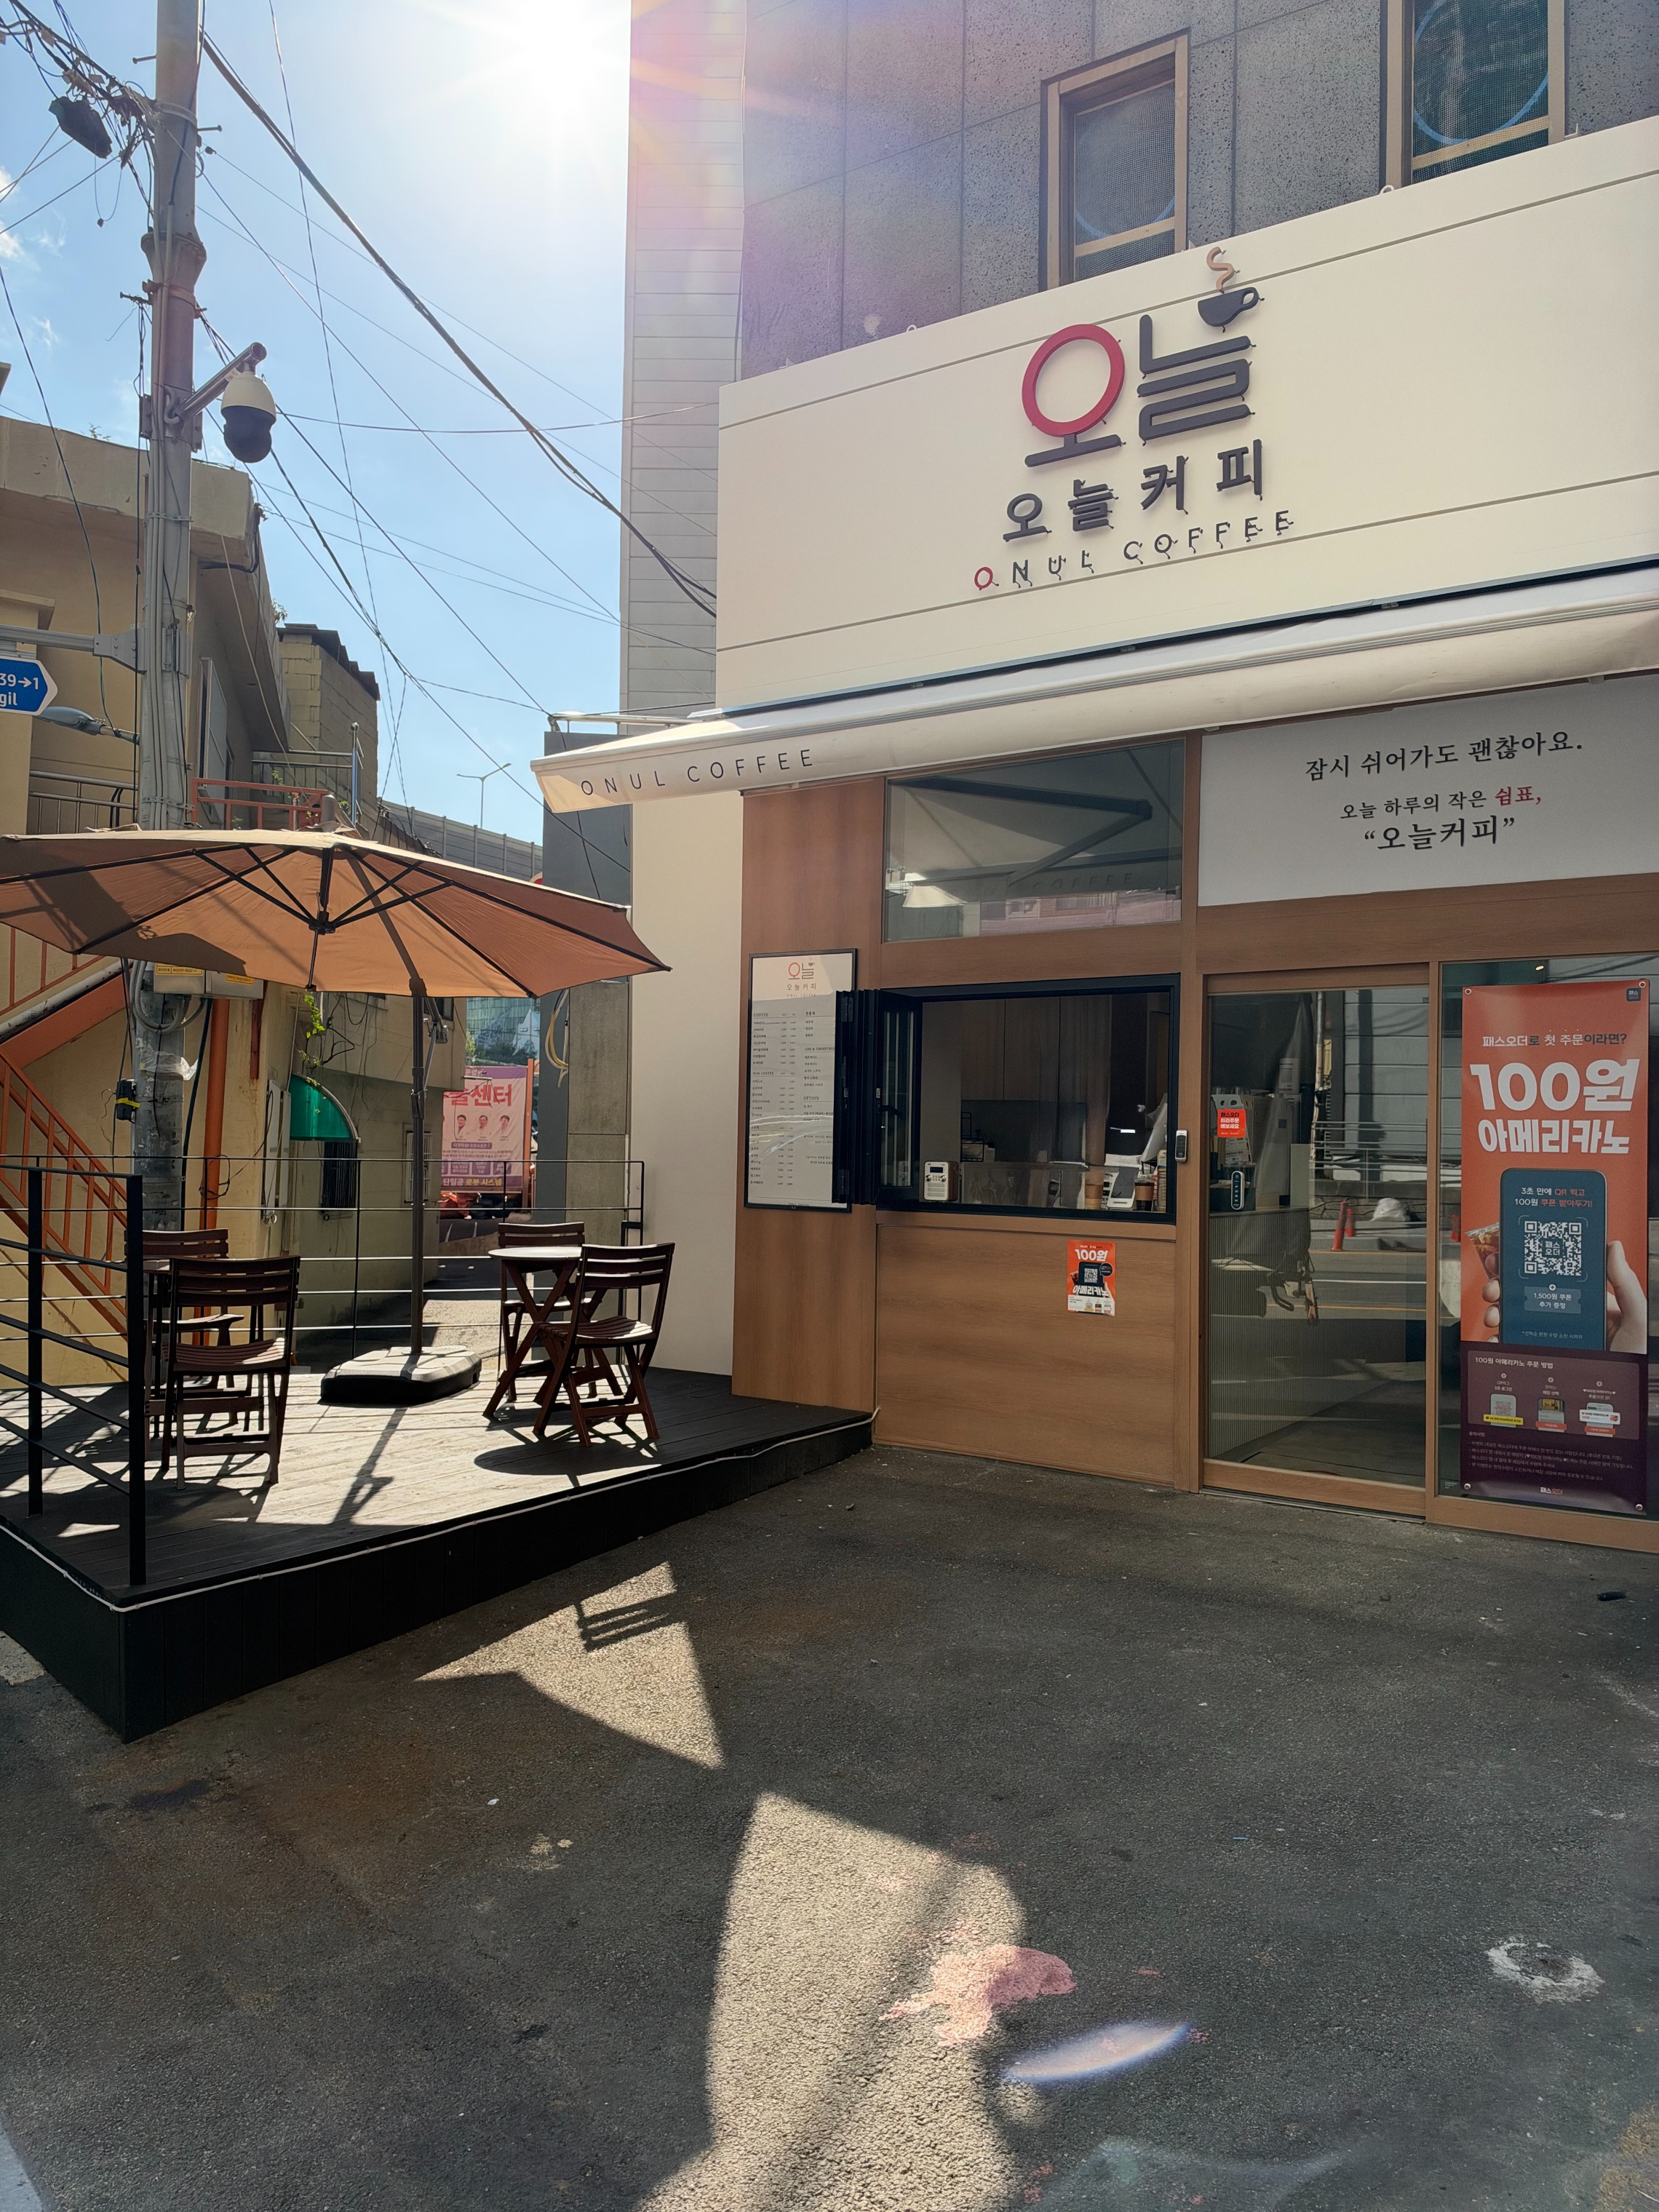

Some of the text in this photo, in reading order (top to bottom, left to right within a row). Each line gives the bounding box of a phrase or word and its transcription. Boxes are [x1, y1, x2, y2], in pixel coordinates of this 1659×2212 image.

[1022, 314, 1252, 468] 오늘
[1003, 439, 1262, 543] 오늘커피
[974, 510, 1292, 590] ONUL COFFEE
[1305, 731, 1583, 781] 잠시 쉬어가도 괜찮아요.
[581, 749, 813, 796] ONUL COFFEE
[1340, 785, 1542, 819] 오늘 하루의 작은 쉼표,
[788, 962, 814, 980] 오늘
[787, 983, 816, 991] 오늘커피
[1483, 1033, 1627, 1048] 패스오더로 첫 주문이라면?
[1470, 1059, 1640, 1111] 100원
[1478, 1118, 1630, 1154] 아메리카노
[442, 1177, 464, 1186] 단일공
[1537, 1187, 1552, 1195] 만에
[1515, 1198, 1538, 1206] 100원
[1545, 1241, 1560, 1249] 패스
[1075, 1249, 1109, 1262] 100원
[1072, 1284, 1110, 1297] 아메리카노
[1533, 1292, 1558, 1300] 1,500원
[1527, 1361, 1539, 1369] 주문
